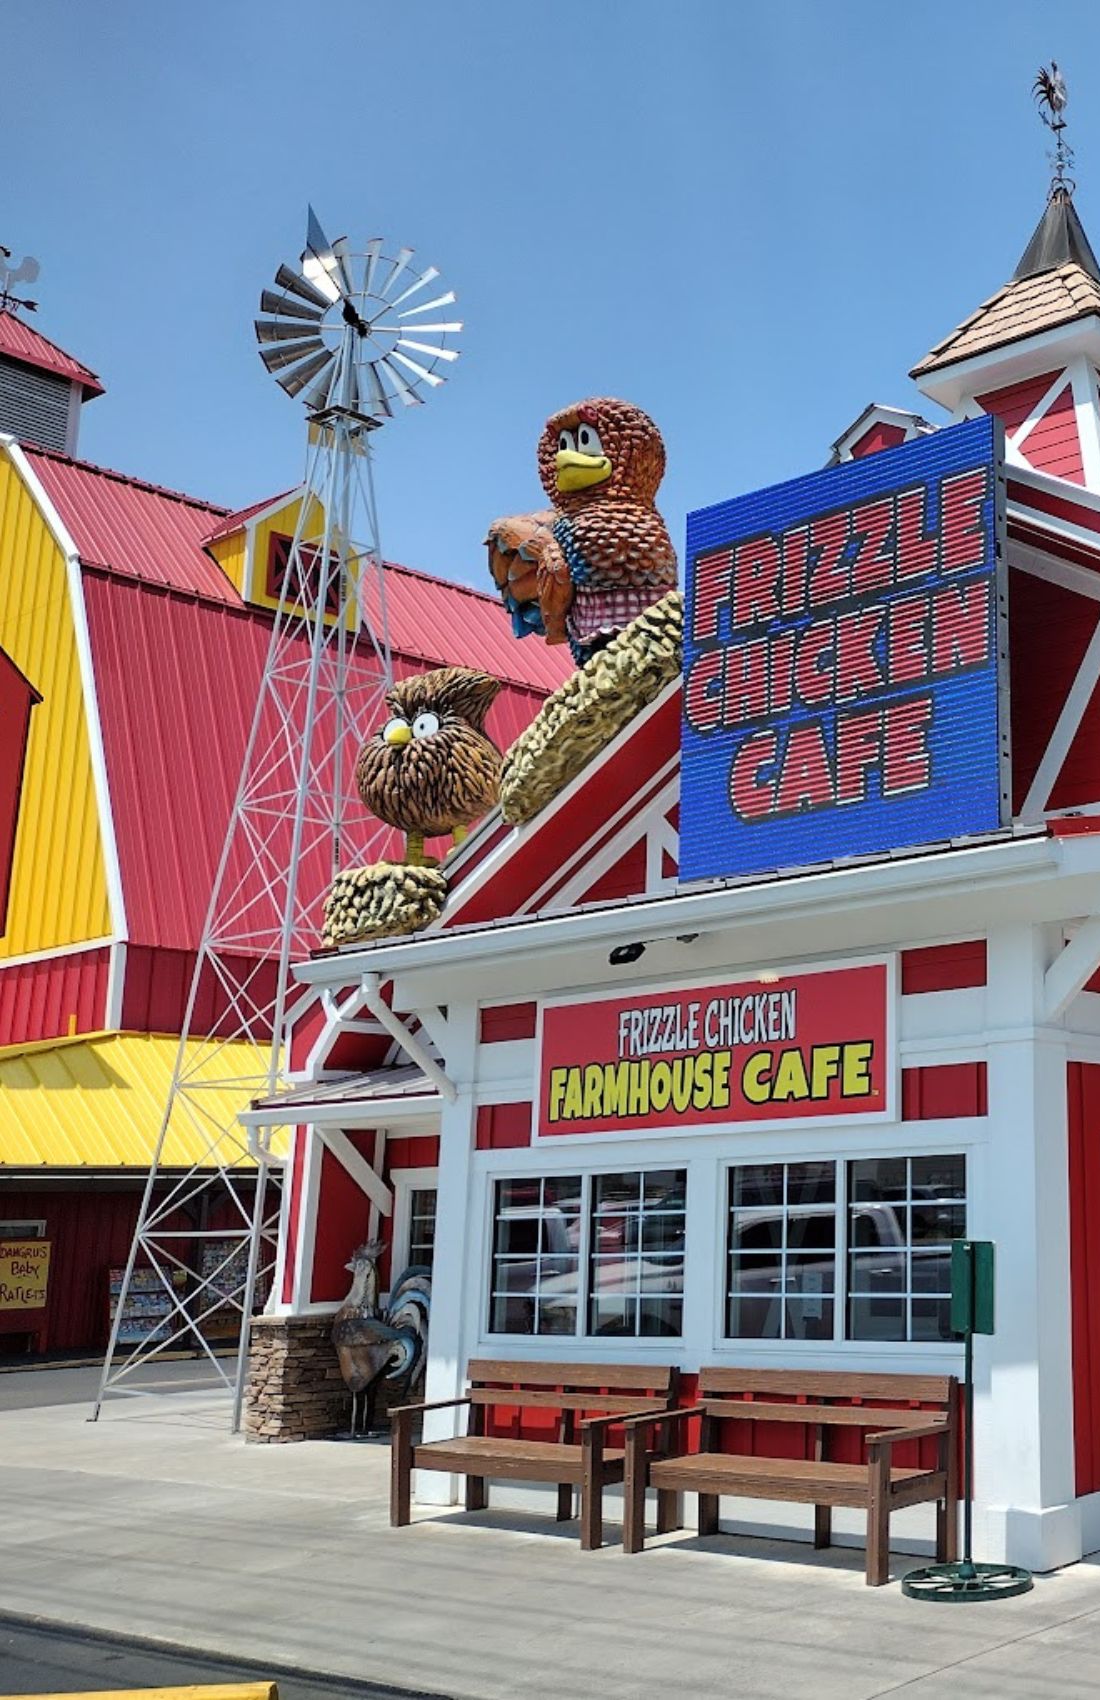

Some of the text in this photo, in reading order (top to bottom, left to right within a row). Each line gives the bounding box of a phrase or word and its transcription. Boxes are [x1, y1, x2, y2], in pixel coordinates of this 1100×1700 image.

[693, 467, 989, 641] FRIZZLE
[686, 580, 991, 731] CHICKEN
[730, 698, 933, 819] CAFE
[548, 1040, 874, 1122] FARMHOUSE CAFE
[617, 989, 797, 1058] FRIZZLE CHICKEN
